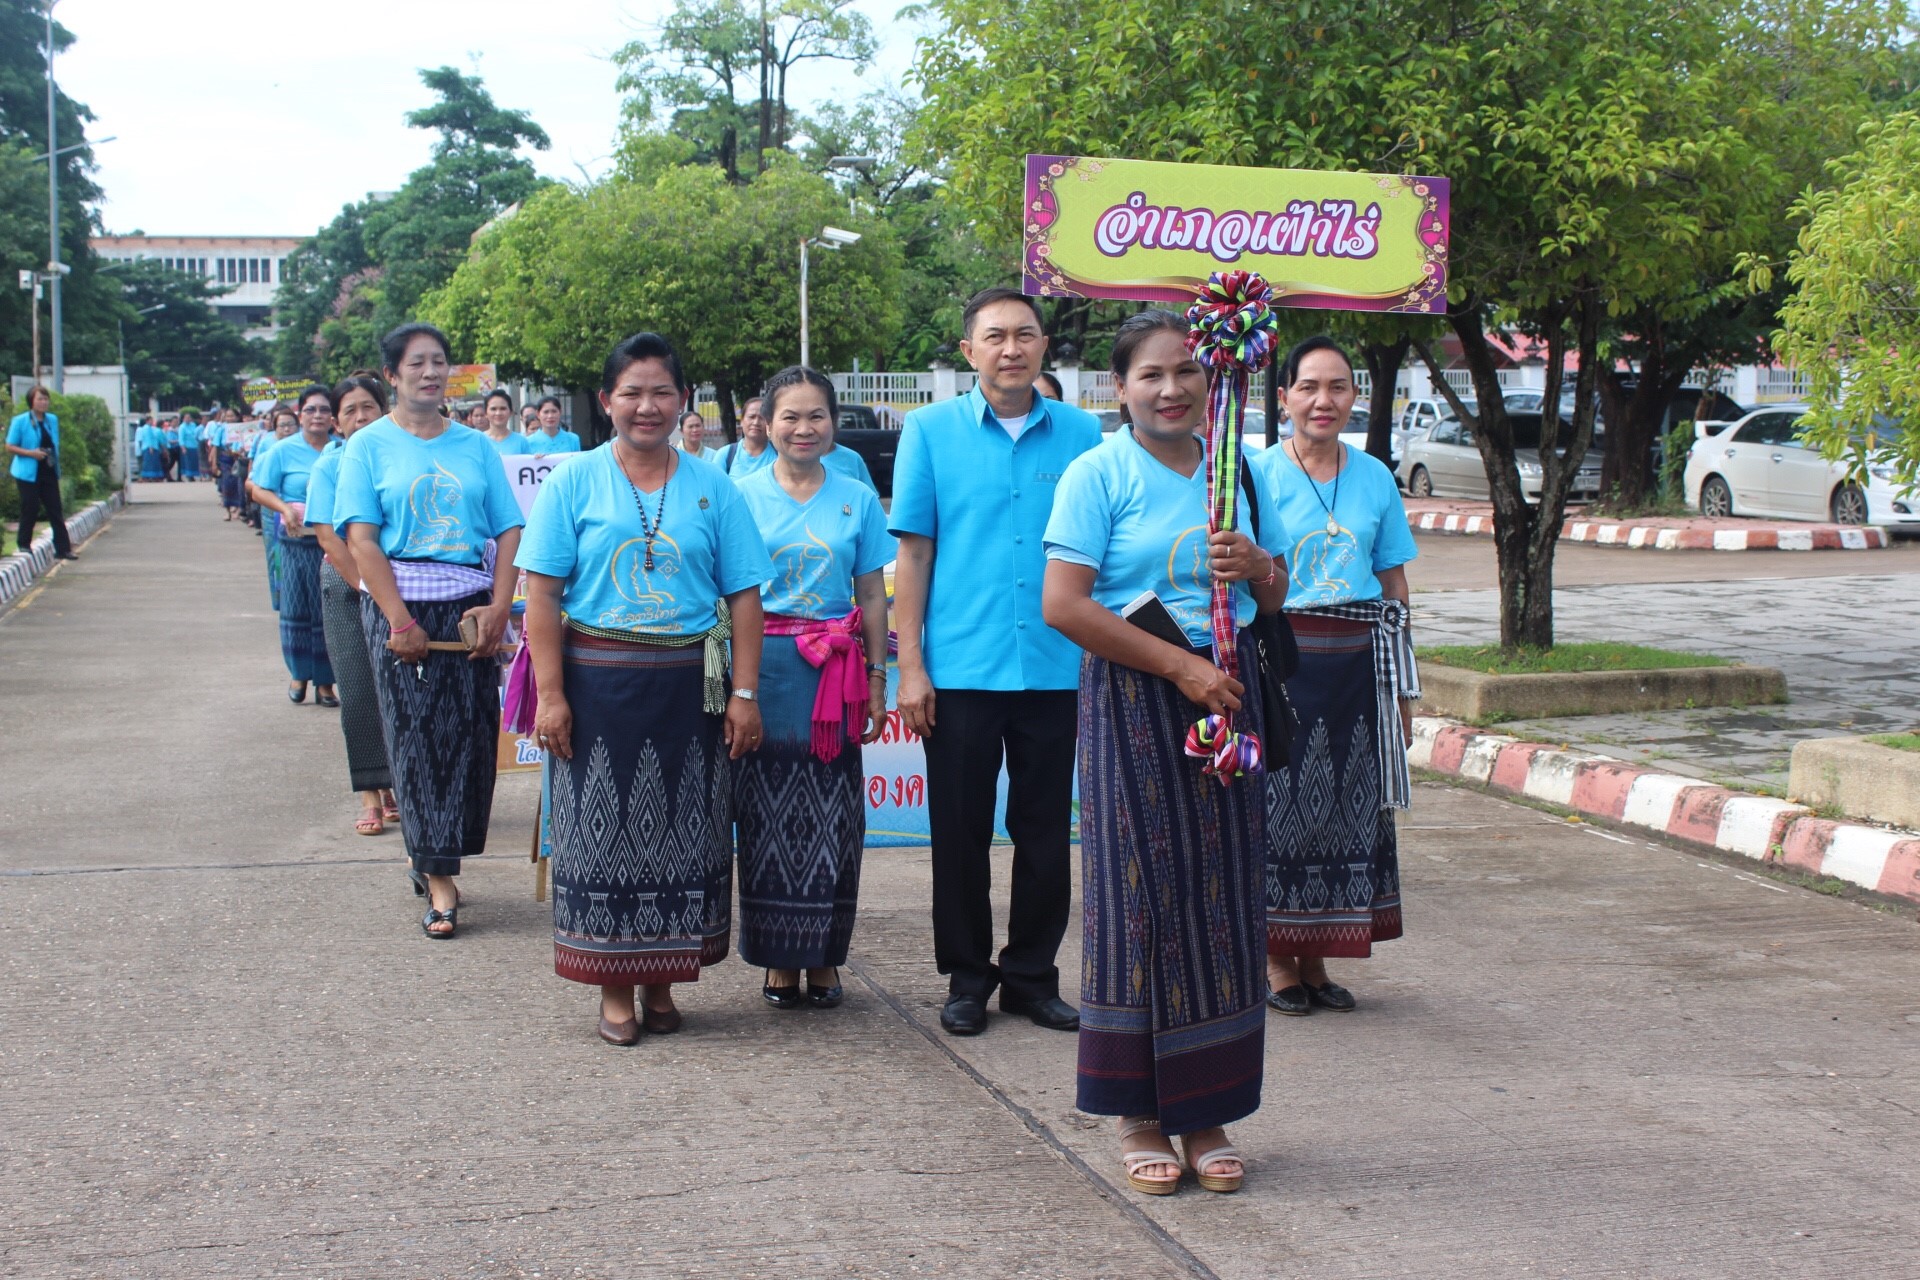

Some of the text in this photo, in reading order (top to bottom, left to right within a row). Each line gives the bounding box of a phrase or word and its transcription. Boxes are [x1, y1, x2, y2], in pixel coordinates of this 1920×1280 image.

[1095, 191, 1382, 262] อำเภอเฝ้าไร่
[518, 465, 556, 486] คว
